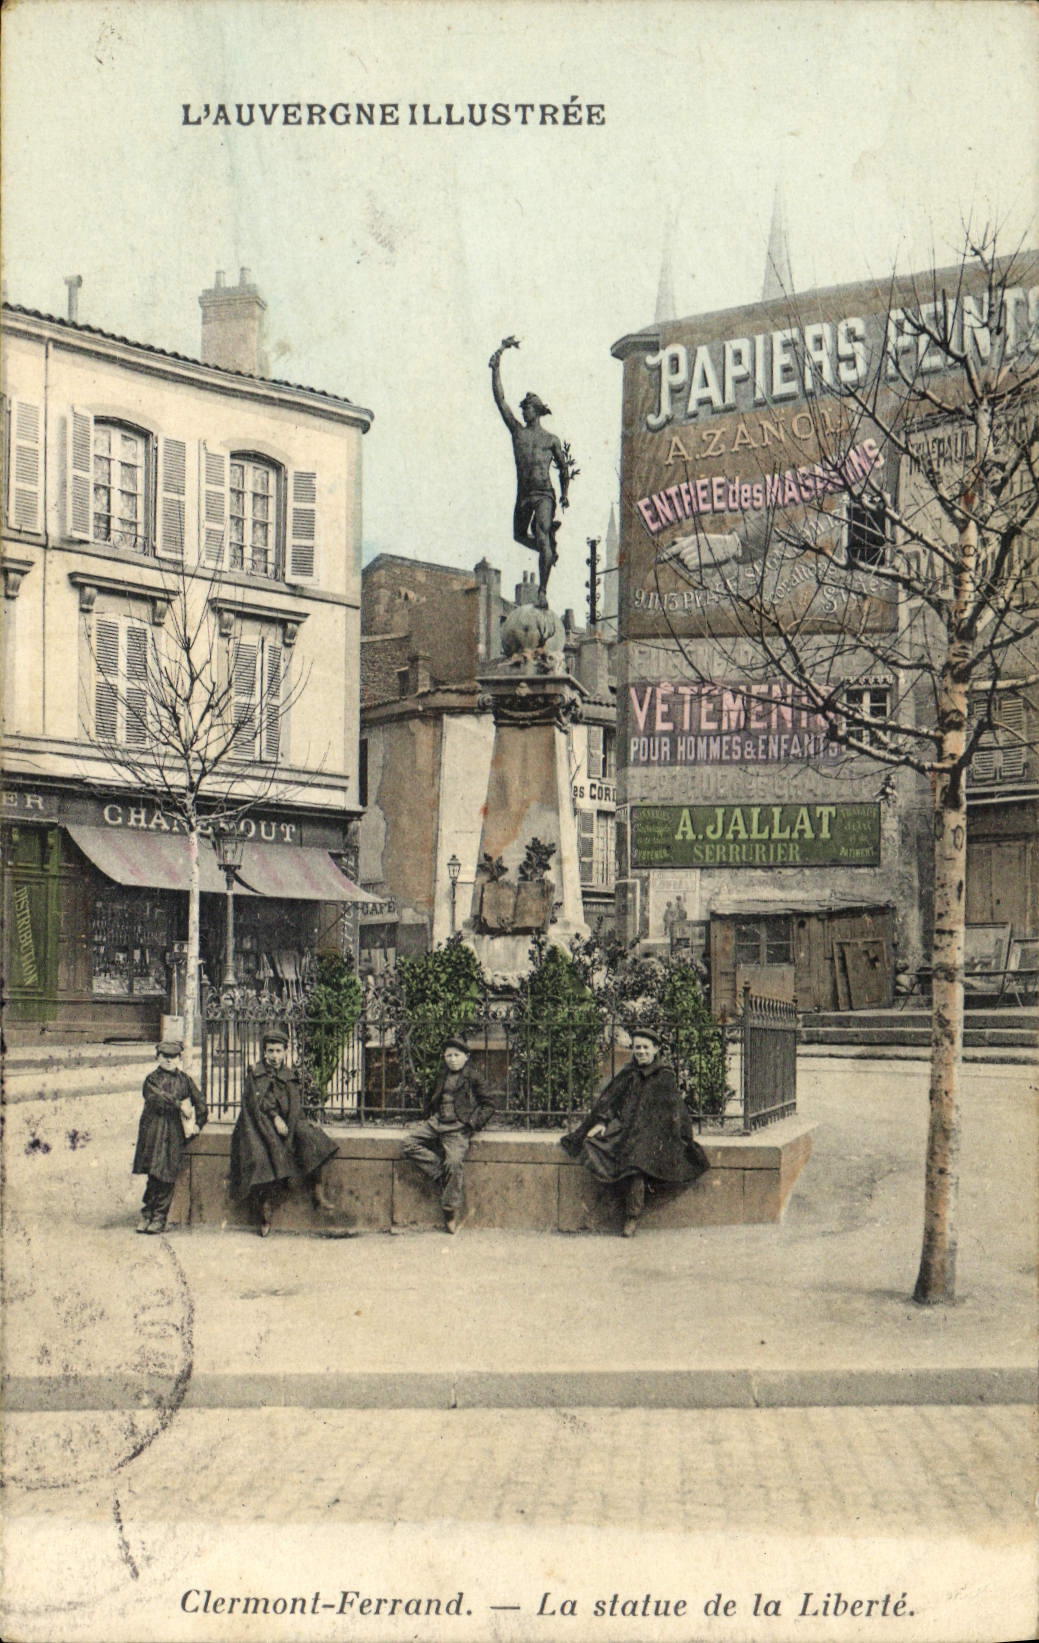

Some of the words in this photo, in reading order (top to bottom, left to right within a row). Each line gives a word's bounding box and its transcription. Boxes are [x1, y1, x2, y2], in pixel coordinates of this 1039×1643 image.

[644, 316, 868, 428] PAPIERS
[630, 735, 671, 763] POUR
[677, 735, 742, 761] HOMMES
[692, 842, 800, 865] SERRURIER
